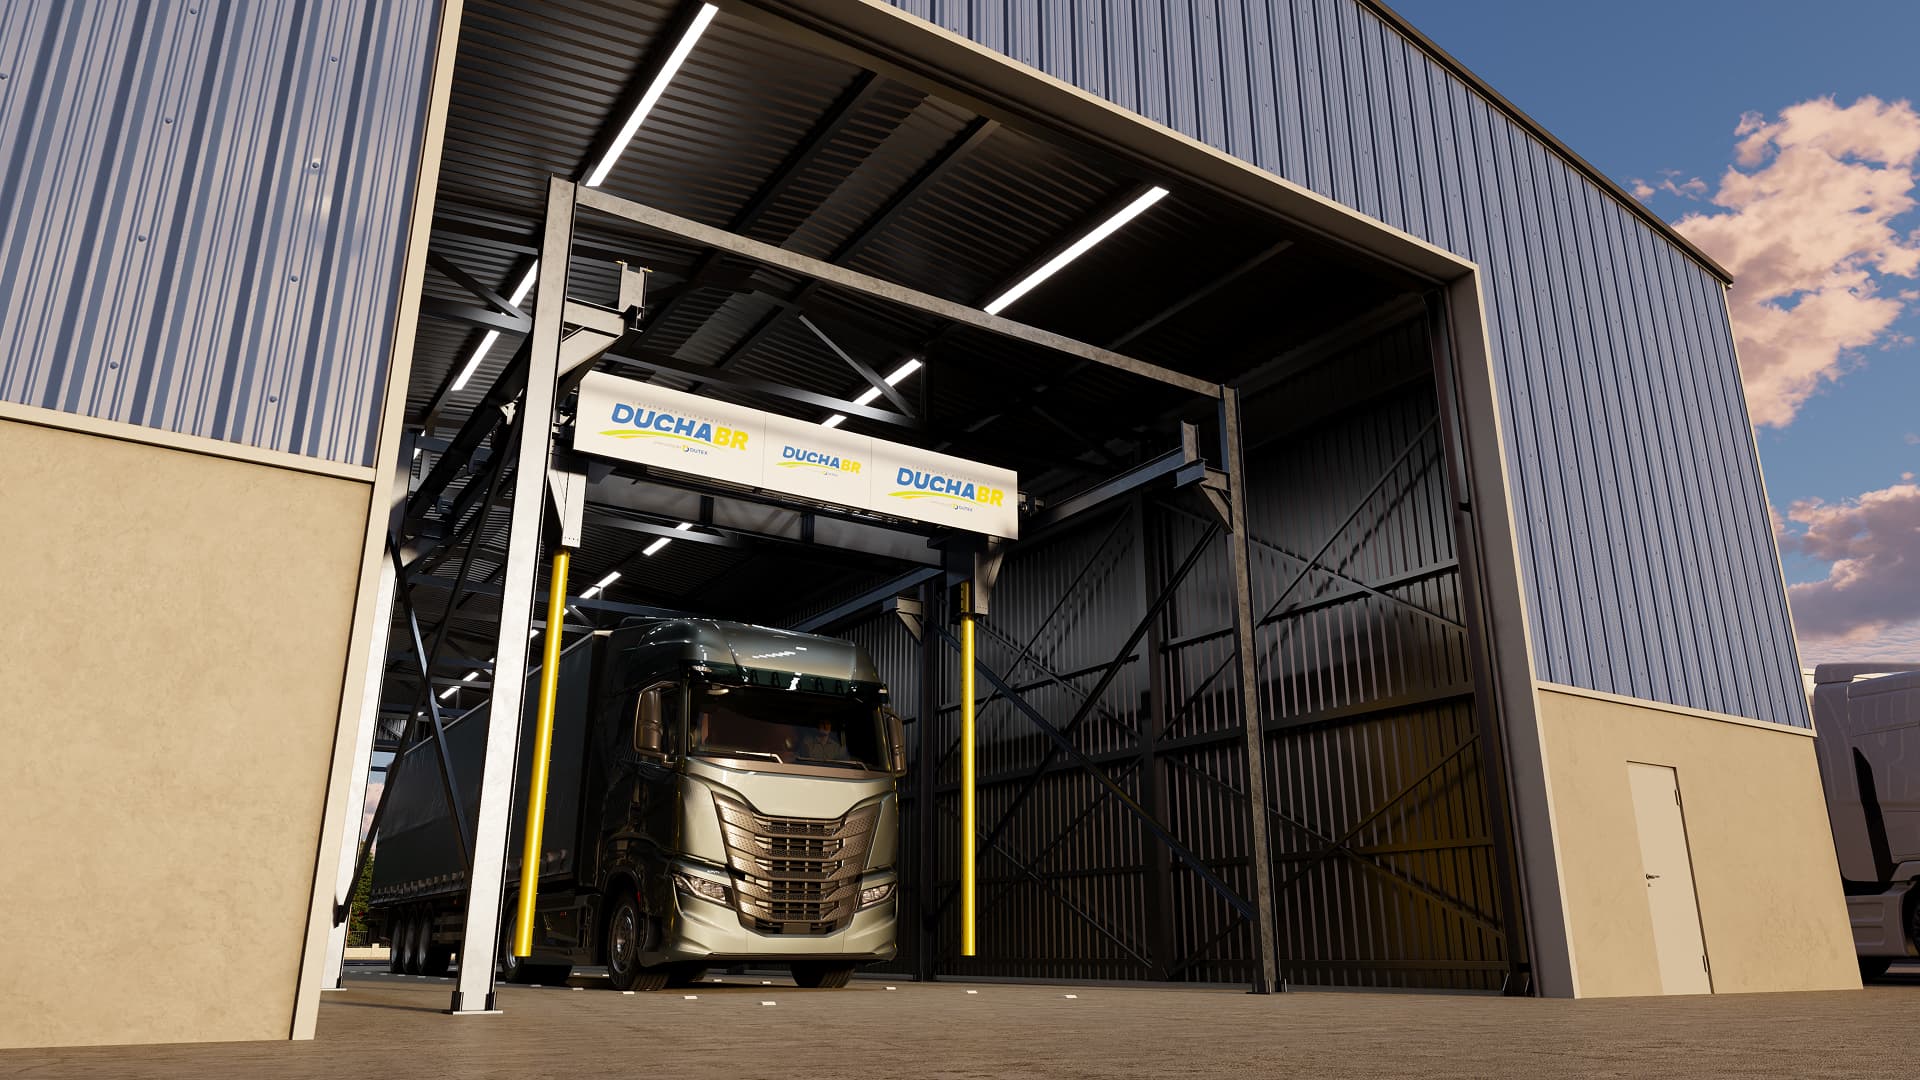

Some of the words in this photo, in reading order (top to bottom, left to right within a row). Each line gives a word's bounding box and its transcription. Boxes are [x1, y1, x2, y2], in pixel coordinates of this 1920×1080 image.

[611, 403, 749, 451] DUCHABR
[783, 446, 862, 474] DUCHABR
[896, 467, 1005, 507] DUCHABR
